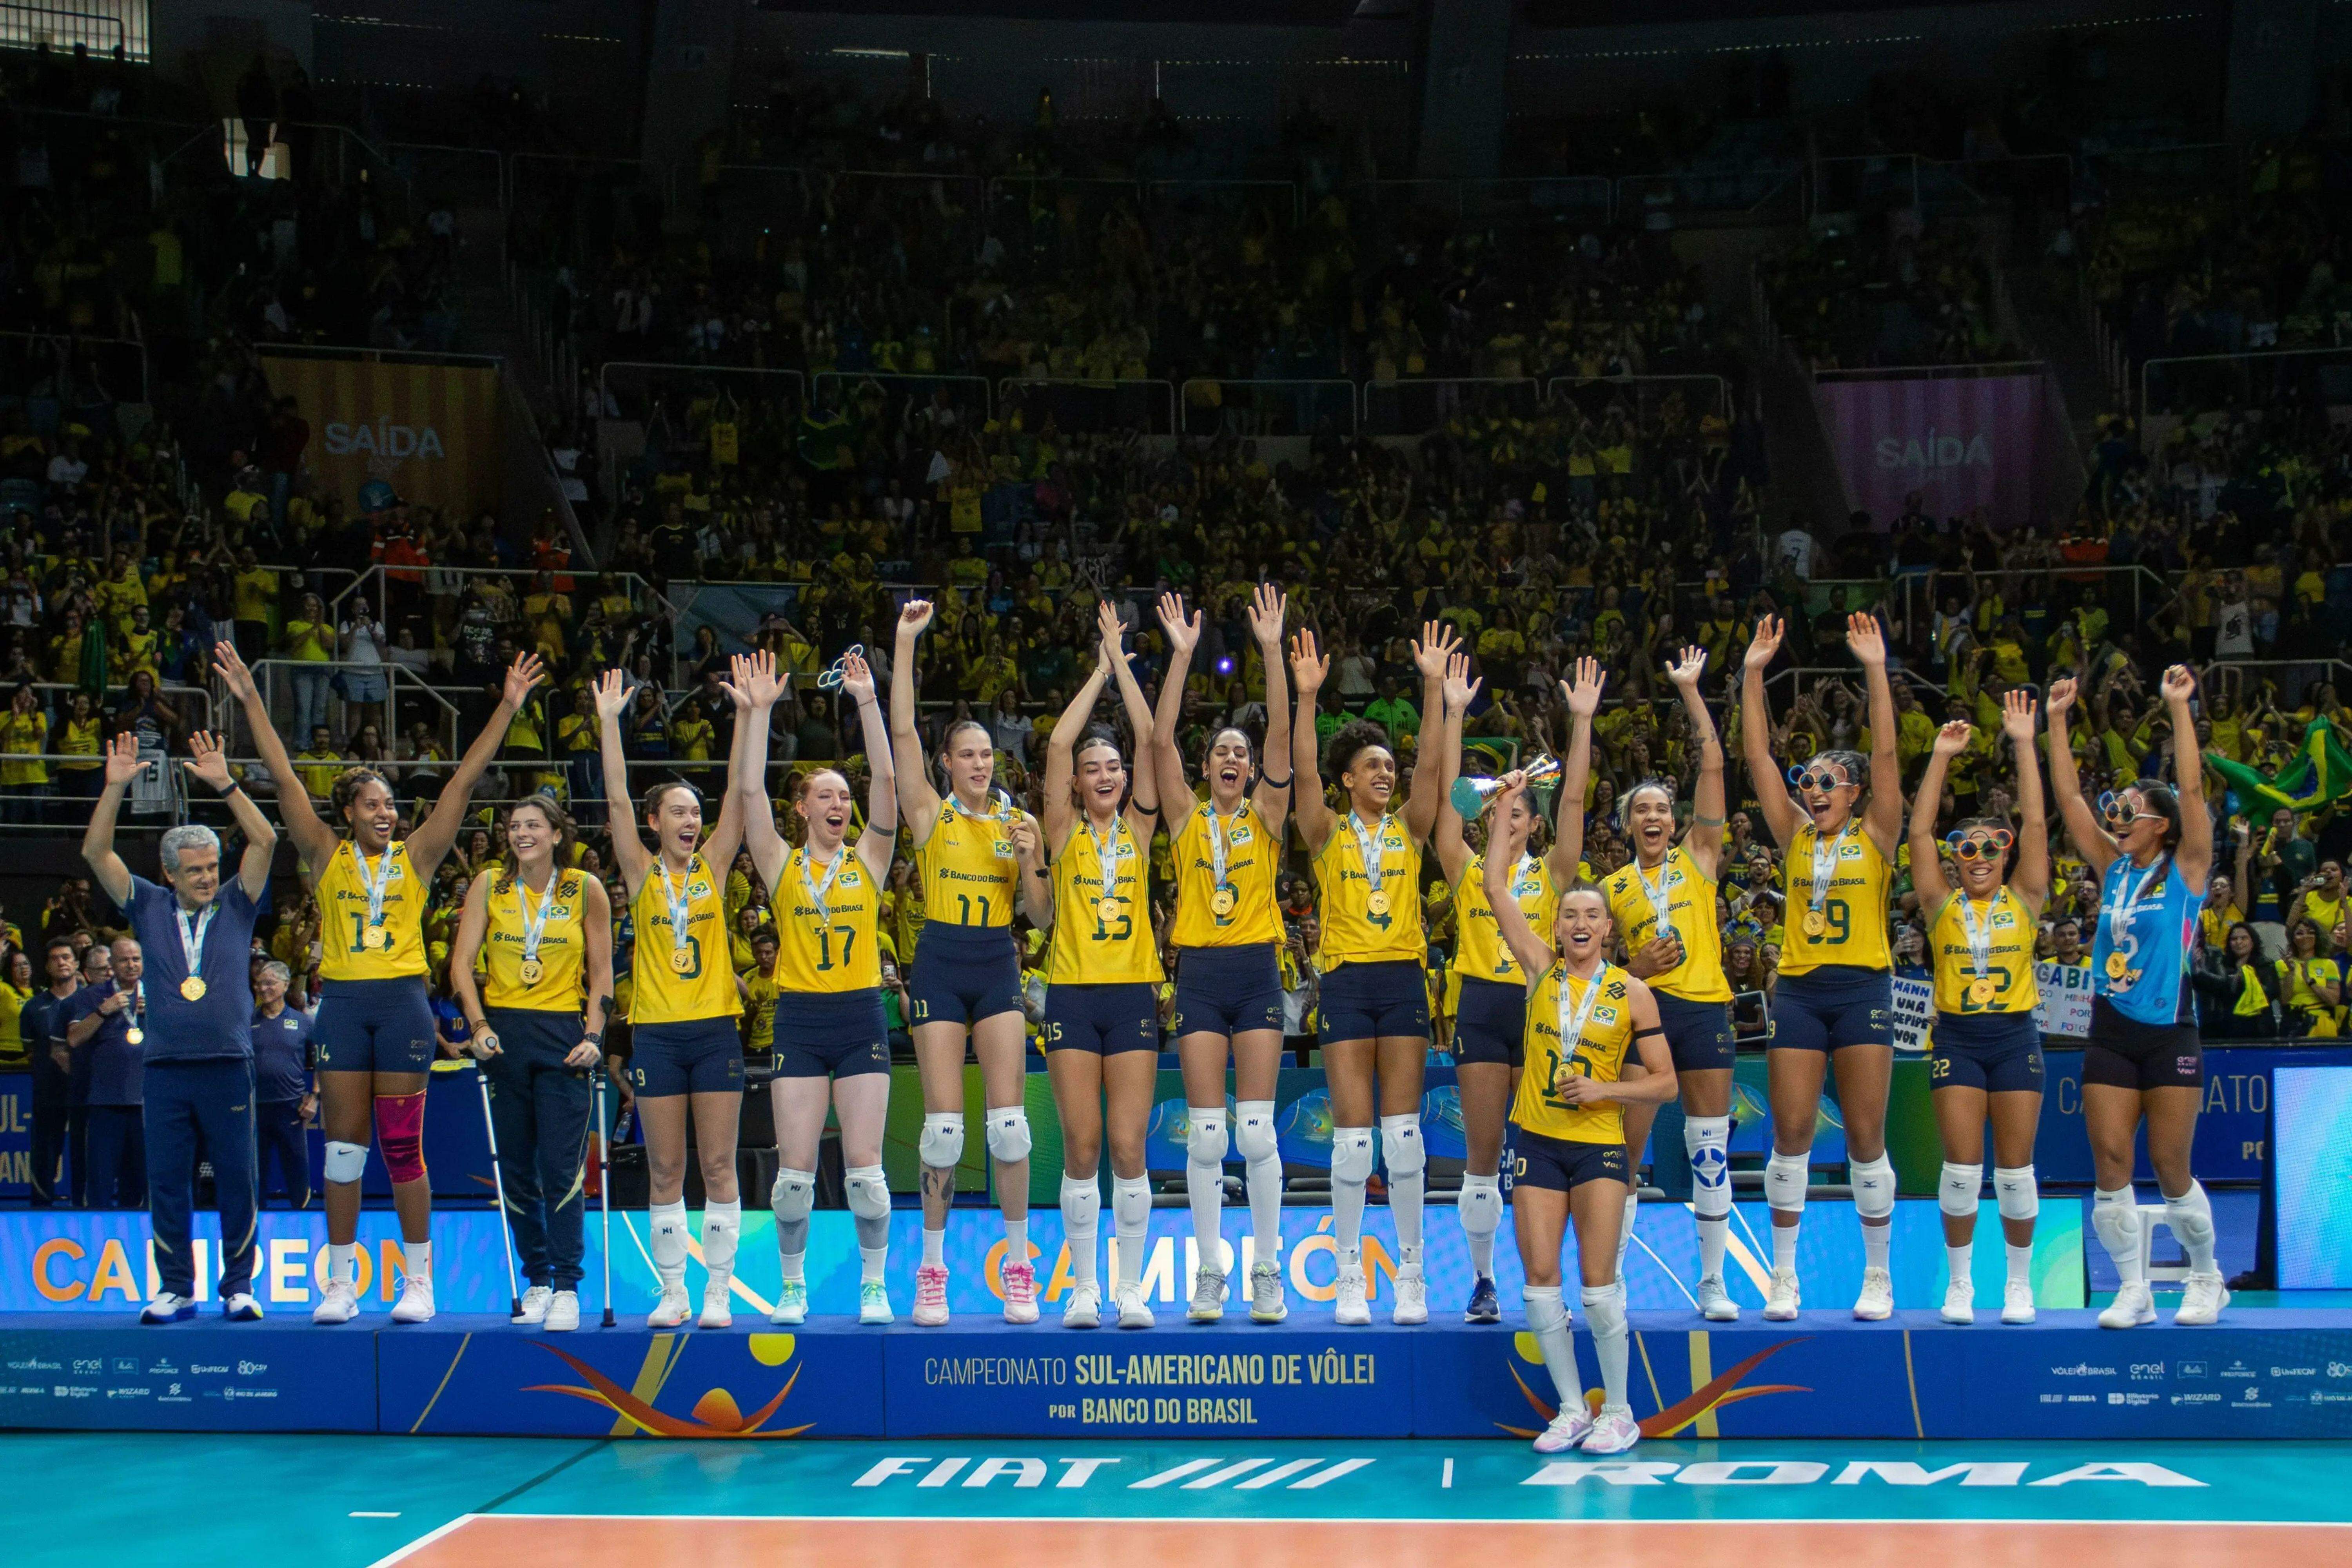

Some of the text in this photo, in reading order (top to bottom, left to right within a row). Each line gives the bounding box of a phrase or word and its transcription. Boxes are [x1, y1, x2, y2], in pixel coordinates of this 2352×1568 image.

[325, 414, 445, 459] SAÍDA
[1877, 427, 1993, 470] SAÍDA
[951, 871, 976, 882] BANCO
[1350, 871, 1370, 880] BANC
[1839, 878, 1866, 886] BRASIL
[958, 894, 989, 927] 11
[1091, 896, 1132, 941] 15
[505, 934, 526, 943] BANC
[814, 925, 857, 971] 17
[2036, 962, 2091, 990] GABI
[1960, 966, 2011, 1013] 22
[914, 1000, 929, 1018] 11
[452, 1018, 464, 1030] 10
[1047, 1022, 1062, 1042] 15
[1322, 1014, 1331, 1031] 4
[1457, 1036, 1465, 1055] 1
[1581, 1038, 1607, 1053] BRASIL
[636, 1068, 646, 1086] 9
[1932, 1058, 1950, 1079] 22
[73, 1357, 102, 1370] enel
[925, 1347, 1374, 1385] CAMPEONATO SUL-AMERICANO DE VÔLEI
[2130, 1360, 2165, 1374] enel
[2183, 1394, 2221, 1402] WIZARD
[1049, 1398, 1258, 1424] POR BANCO DO BRASIL
[851, 1457, 1120, 1488] FIAT
[1519, 1460, 2212, 1487] ROMA
